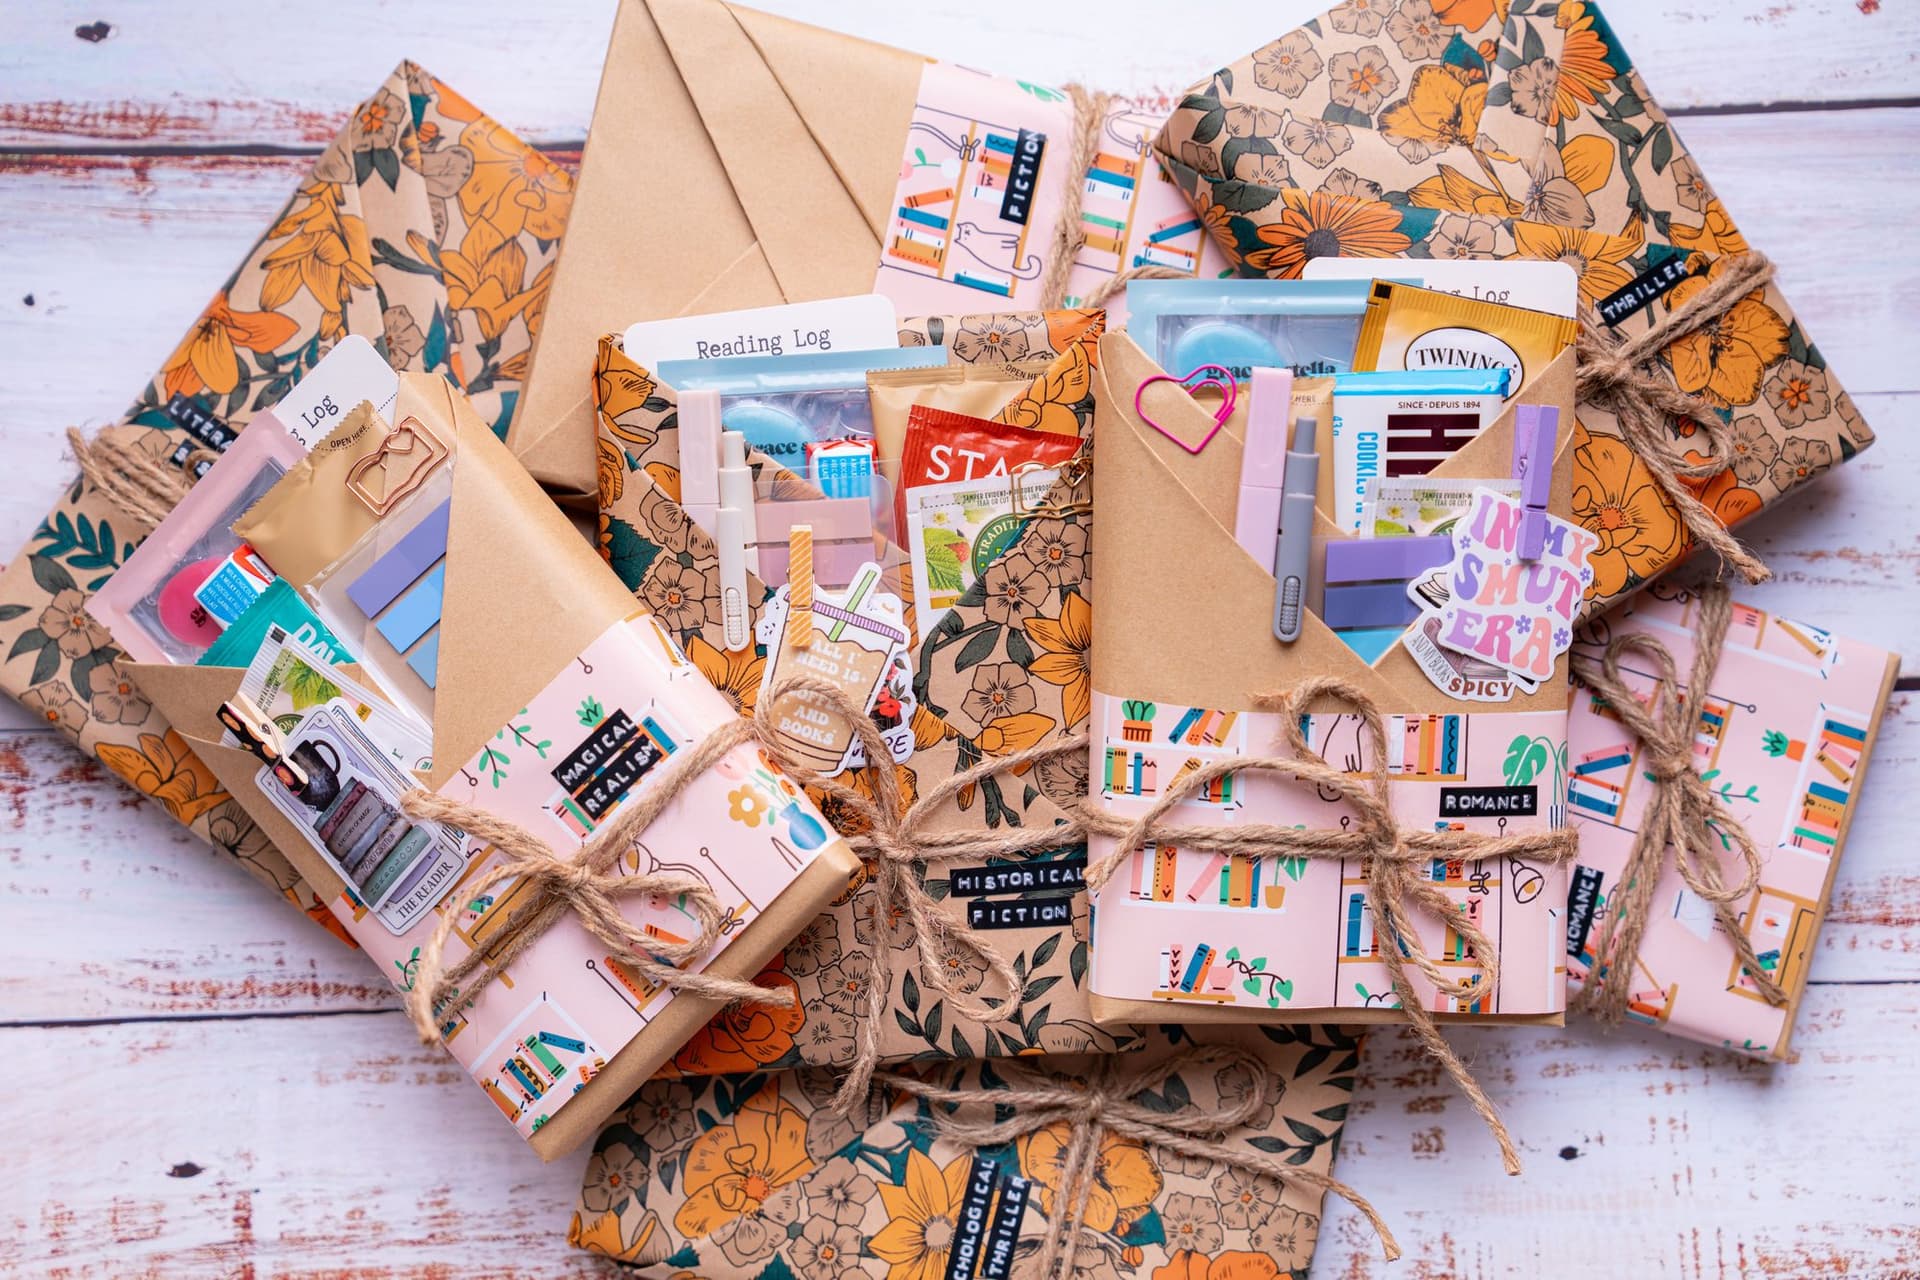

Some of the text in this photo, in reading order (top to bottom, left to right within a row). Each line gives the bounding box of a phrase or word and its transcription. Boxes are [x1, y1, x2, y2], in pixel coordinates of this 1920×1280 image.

[1009, 131, 1044, 217] FICTION
[697, 329, 831, 359] Reading Log
[1005, 364, 1026, 378] OPEN
[1289, 361, 1336, 377] tella
[301, 395, 338, 428] Log
[1398, 401, 1481, 409] SINCE DEPUIS 1894
[330, 424, 367, 448] OPEN HERE
[926, 445, 1045, 480] STA
[962, 492, 983, 501] TAMPER
[1470, 495, 1520, 552] IN
[1454, 553, 1580, 621] SMUT
[811, 640, 842, 659] ALL
[1446, 608, 1552, 676] ERA
[796, 652, 839, 675] NEED
[1448, 677, 1514, 697] SPICY
[793, 705, 829, 725] AND
[780, 717, 834, 745] BOOKS
[561, 719, 635, 786] MAGICAL
[585, 742, 656, 813] REALISM
[1445, 794, 1532, 810] ROMANCE
[396, 861, 453, 919] THE READER
[958, 867, 1083, 890] HISTORICAL
[973, 905, 1067, 923] FICTION
[1568, 866, 1599, 951] ROMANCE
[989, 1175, 1025, 1276] THRILLER
